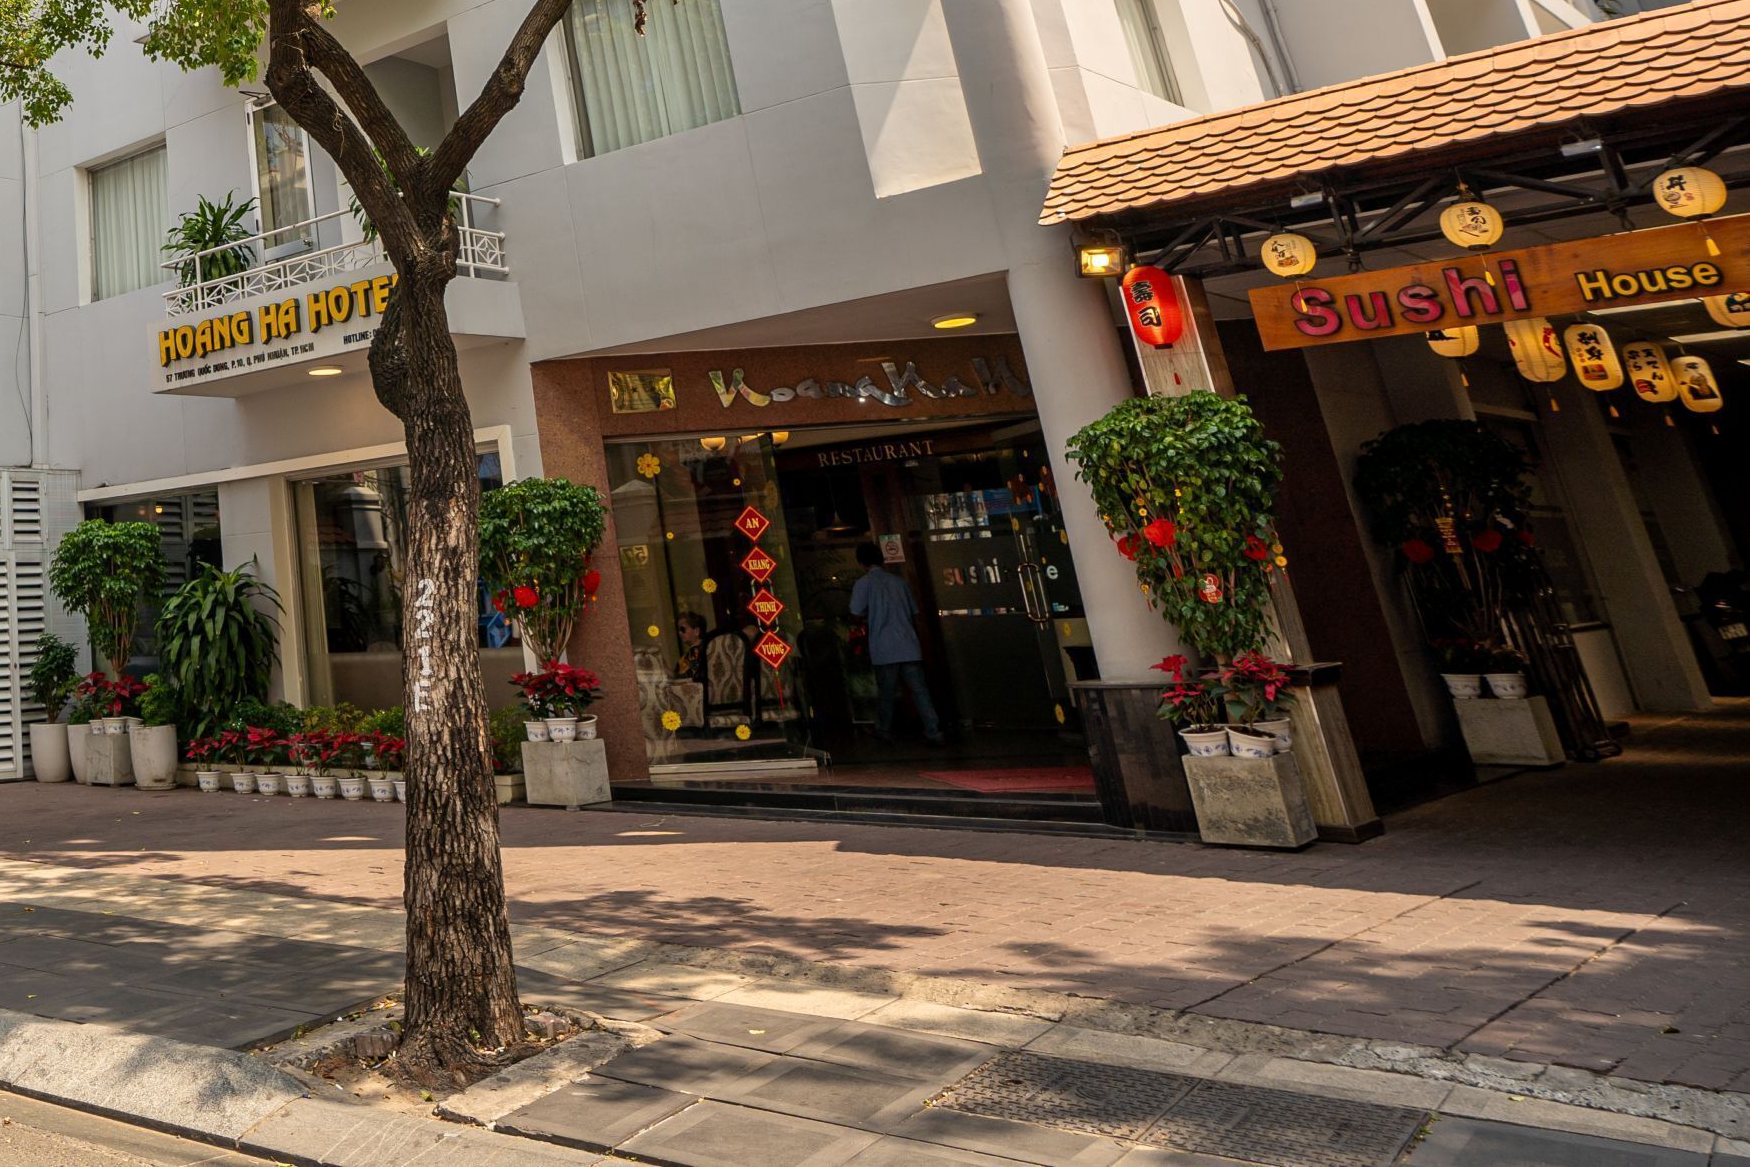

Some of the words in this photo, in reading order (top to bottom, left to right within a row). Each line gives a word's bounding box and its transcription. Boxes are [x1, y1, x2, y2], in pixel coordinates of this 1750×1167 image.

[1291, 258, 1531, 336] Sushi
[1575, 261, 1723, 303] House
[158, 311, 253, 367] HOANG
[258, 298, 301, 345] HA
[343, 329, 372, 345] HOTLINE:
[818, 440, 933, 467] RESTAURANT
[745, 518, 759, 529] AN
[748, 559, 770, 571] KHANG
